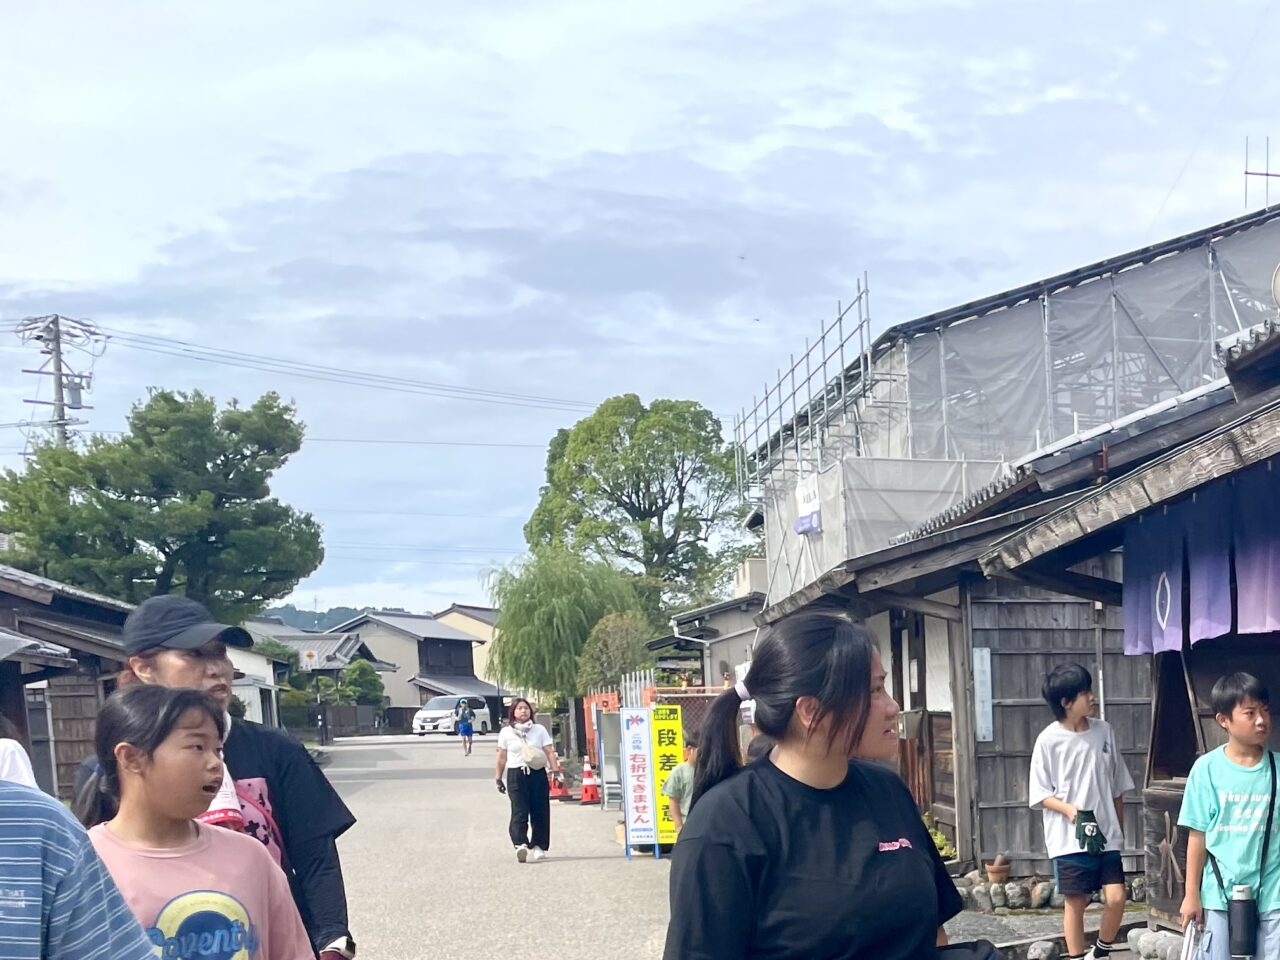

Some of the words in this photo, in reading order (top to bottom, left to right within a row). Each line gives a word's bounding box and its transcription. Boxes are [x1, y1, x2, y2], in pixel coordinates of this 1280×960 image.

[629, 753, 650, 824] 右折できません
[657, 729, 678, 822] 段差意
